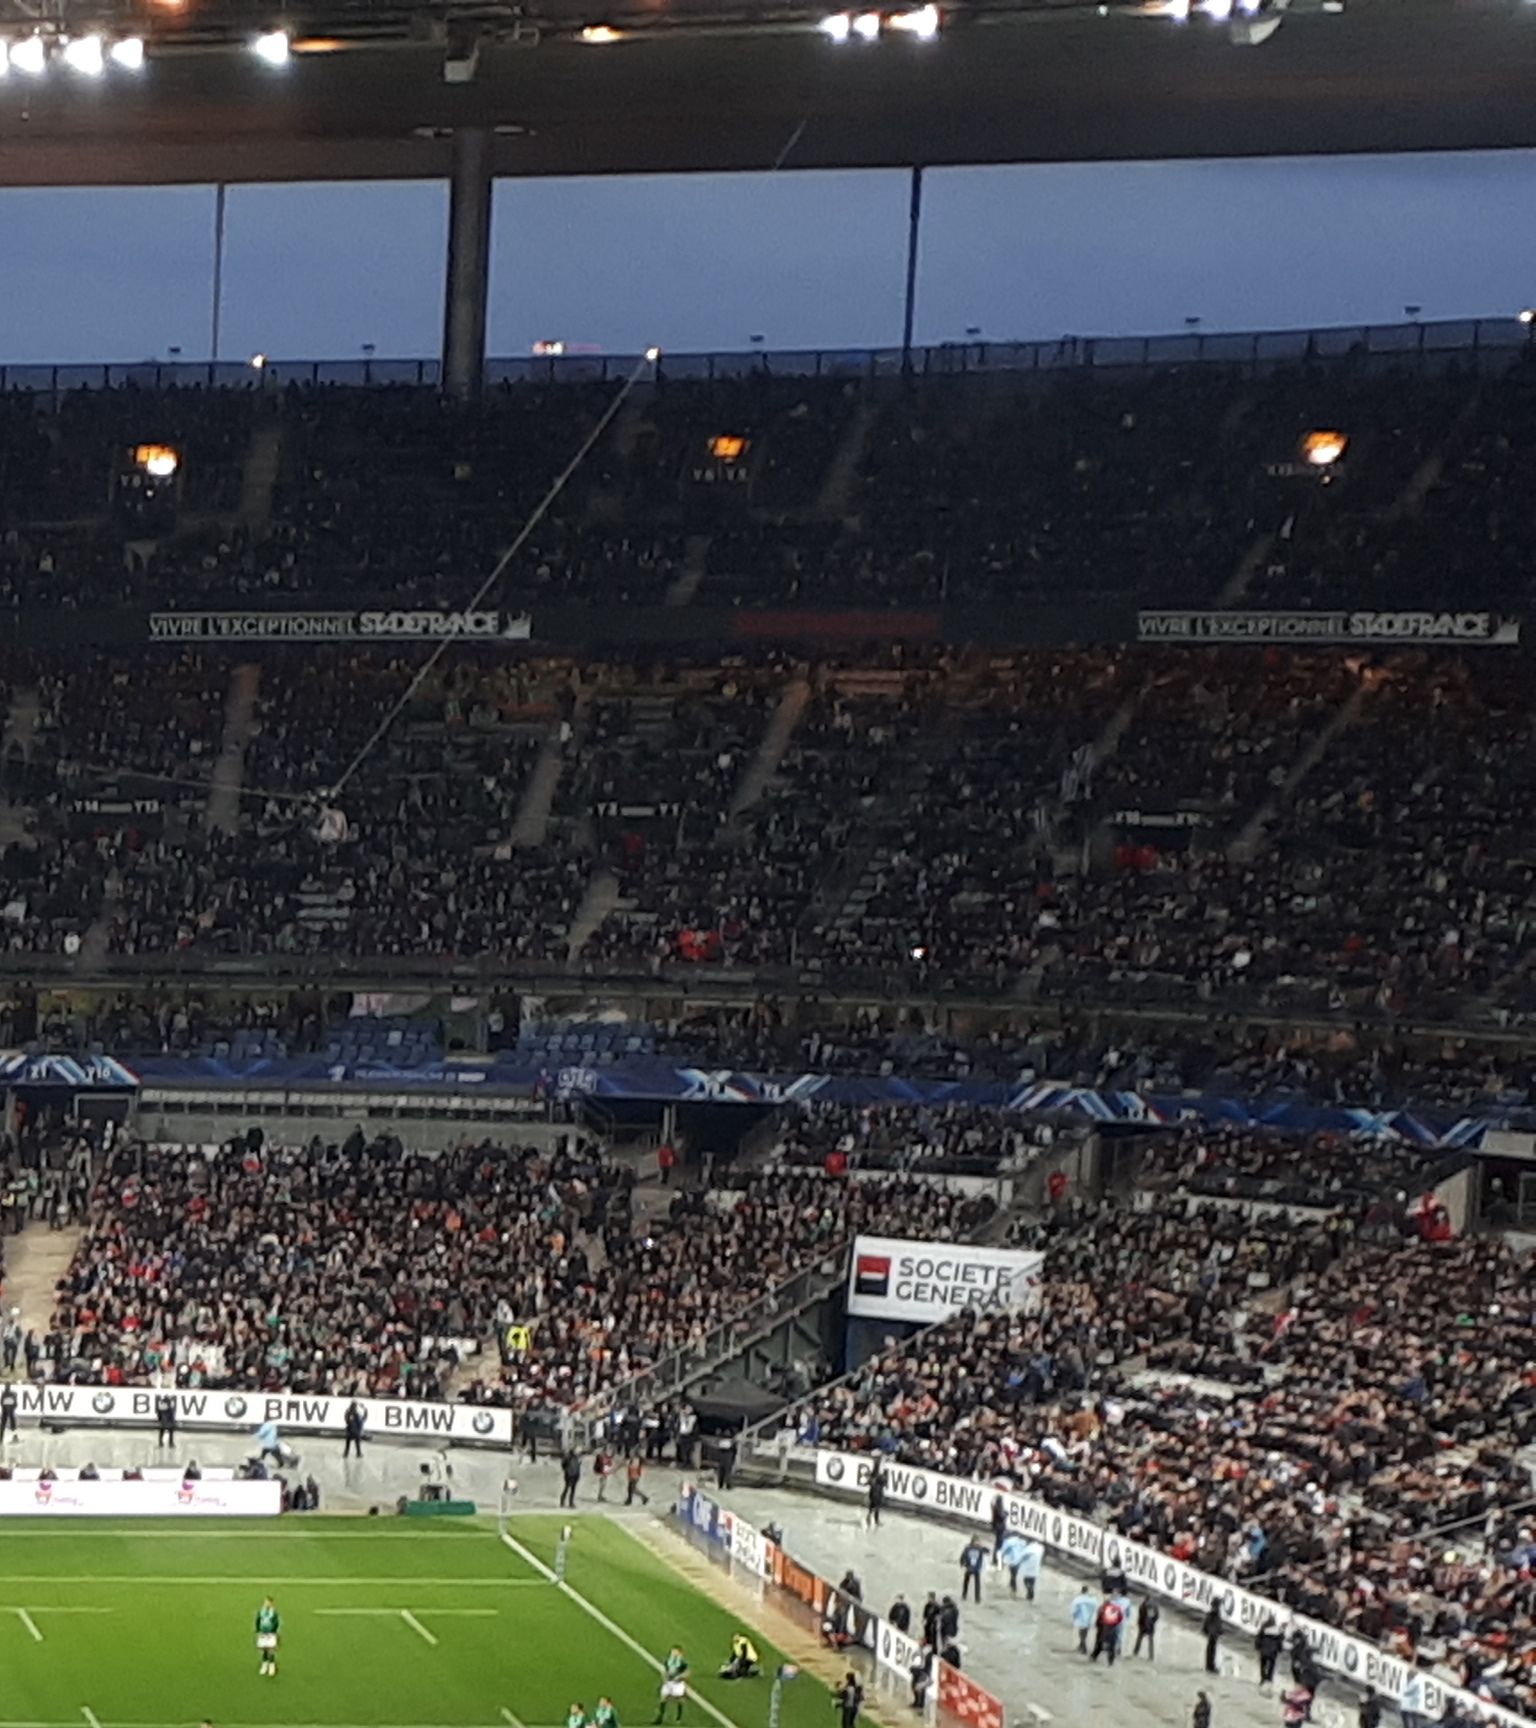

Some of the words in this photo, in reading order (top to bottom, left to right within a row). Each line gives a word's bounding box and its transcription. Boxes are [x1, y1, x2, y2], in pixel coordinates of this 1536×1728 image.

[898, 1257, 1015, 1288] SOCIETE
[384, 1405, 456, 1433] BMW
[935, 1480, 983, 1514] BMW
[1009, 1500, 1048, 1537] BMW
[1366, 1656, 1404, 1694] BMW
